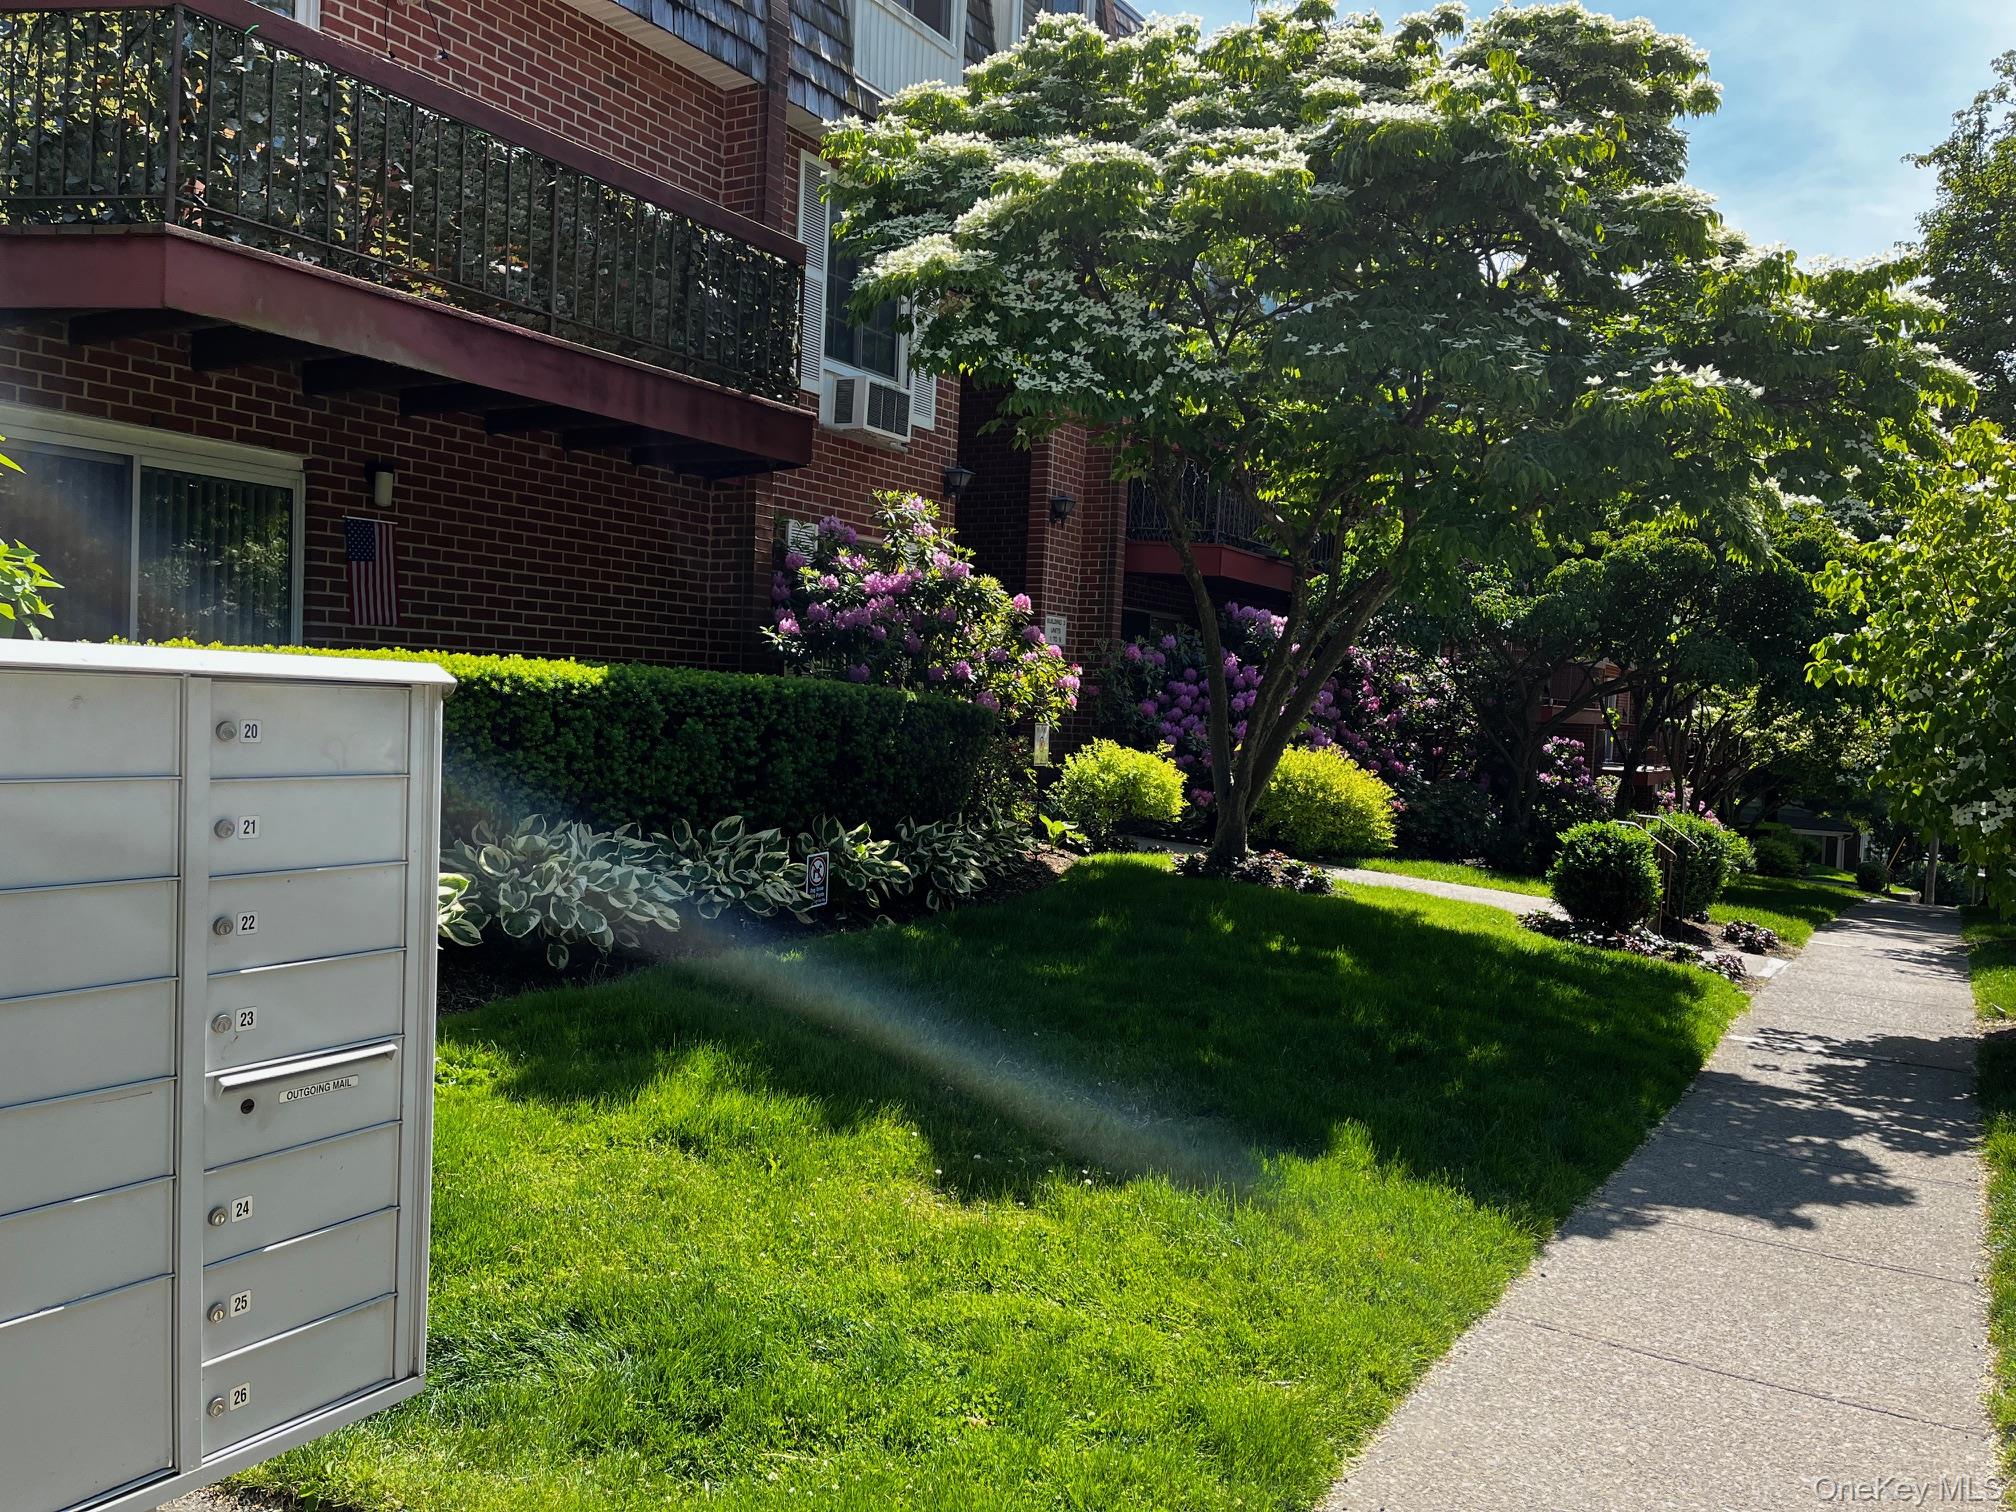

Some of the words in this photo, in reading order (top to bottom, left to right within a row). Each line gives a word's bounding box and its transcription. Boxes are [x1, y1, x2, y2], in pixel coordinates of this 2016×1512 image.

[244, 724, 258, 739] 20
[243, 820, 256, 834] 21
[241, 915, 255, 930] 22
[240, 1011, 254, 1027] 23
[287, 1082, 331, 1100] OUTGOING
[332, 1078, 352, 1091] MAIL
[235, 1200, 249, 1217] 24
[234, 1295, 248, 1312] 25
[233, 1388, 247, 1405] 26
